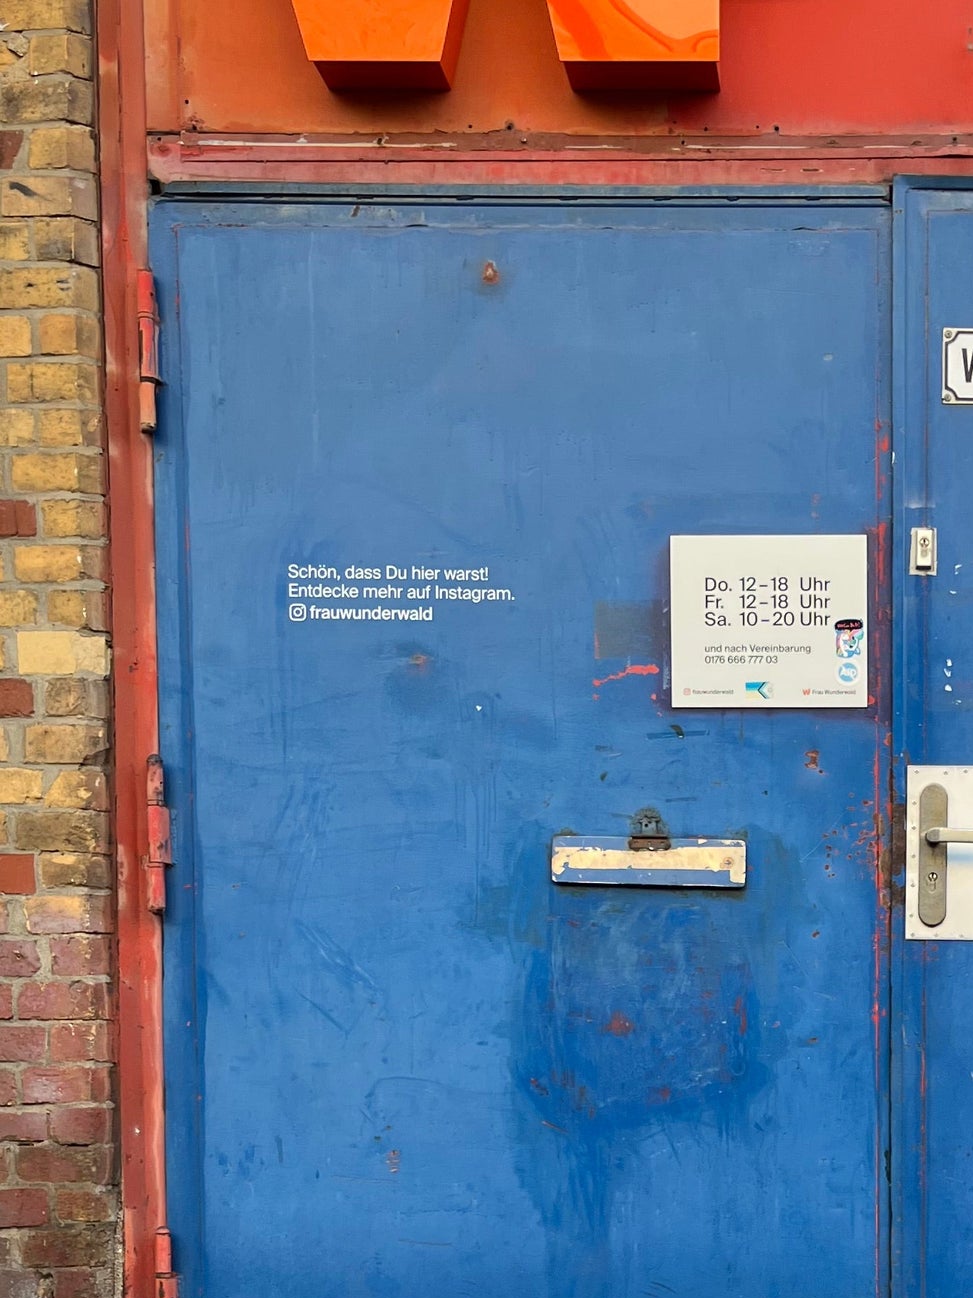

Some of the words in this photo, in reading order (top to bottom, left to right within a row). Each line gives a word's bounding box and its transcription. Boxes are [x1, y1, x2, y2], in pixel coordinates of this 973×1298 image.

[288, 563, 341, 581] Schön,
[345, 565, 382, 580] dass
[386, 565, 408, 580] Du
[411, 566, 440, 580] hier
[444, 566, 489, 581] warst!
[704, 577, 733, 592] Do.
[800, 577, 831, 592] Uhr
[288, 582, 359, 599] Entdecke
[363, 584, 403, 599] mehr
[406, 585, 432, 600] auf
[435, 585, 515, 604] Instagram.
[704, 594, 724, 609] Fr.
[800, 594, 831, 609] Uhr
[309, 604, 433, 621] frauwunderwald
[704, 612, 732, 627] Sa.
[800, 612, 831, 627] Uhr
[704, 645, 723, 653] und
[725, 645, 748, 653] nach
[749, 644, 812, 655] Vereinbarung
[704, 655, 726, 664] 0176
[728, 655, 746, 664] 666
[748, 655, 764, 664] 777
[766, 655, 779, 664] 03
